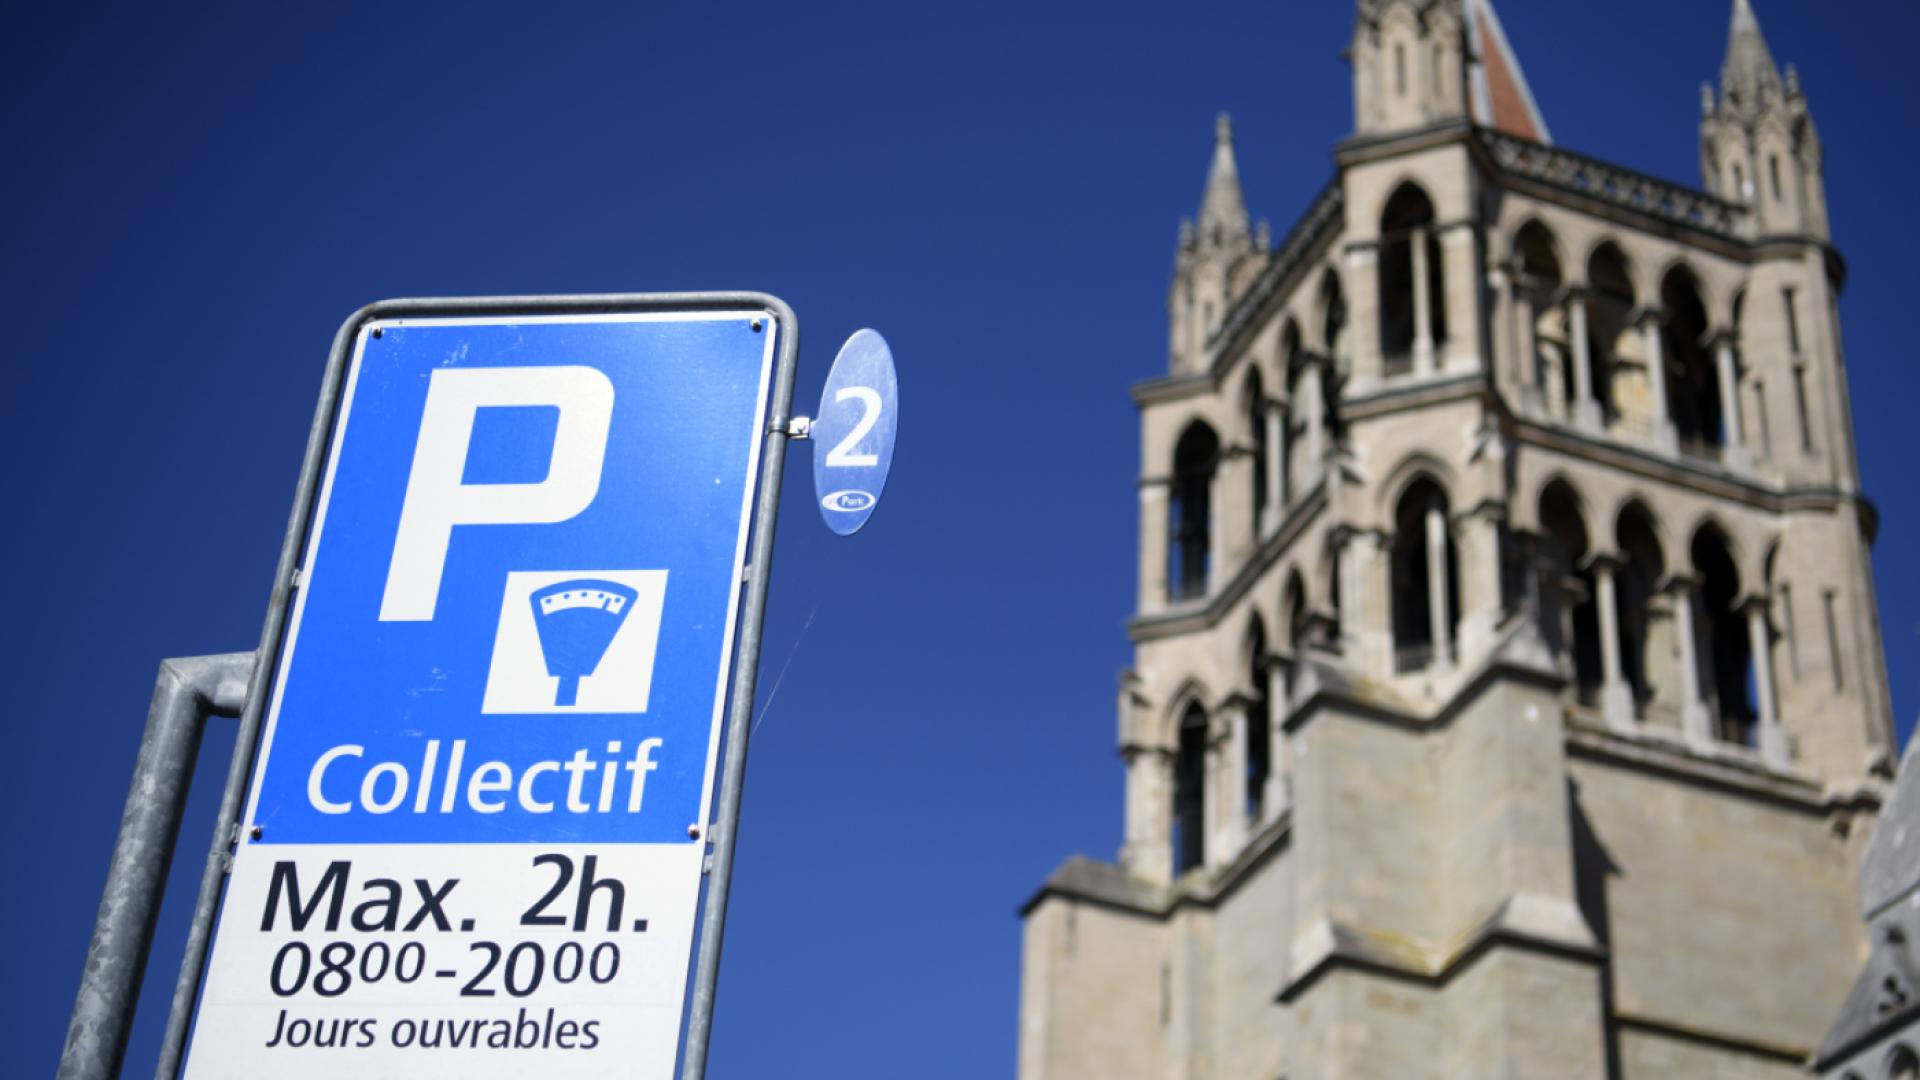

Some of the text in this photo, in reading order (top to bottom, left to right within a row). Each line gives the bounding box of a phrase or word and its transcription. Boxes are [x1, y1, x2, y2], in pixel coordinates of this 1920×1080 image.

[825, 386, 882, 467] 2
[378, 365, 615, 622] P
[841, 495, 865, 506] Park
[307, 737, 663, 815] Collectif
[260, 853, 650, 933] Max. 2h.
[265, 1008, 600, 1050] Jours ouvrables
